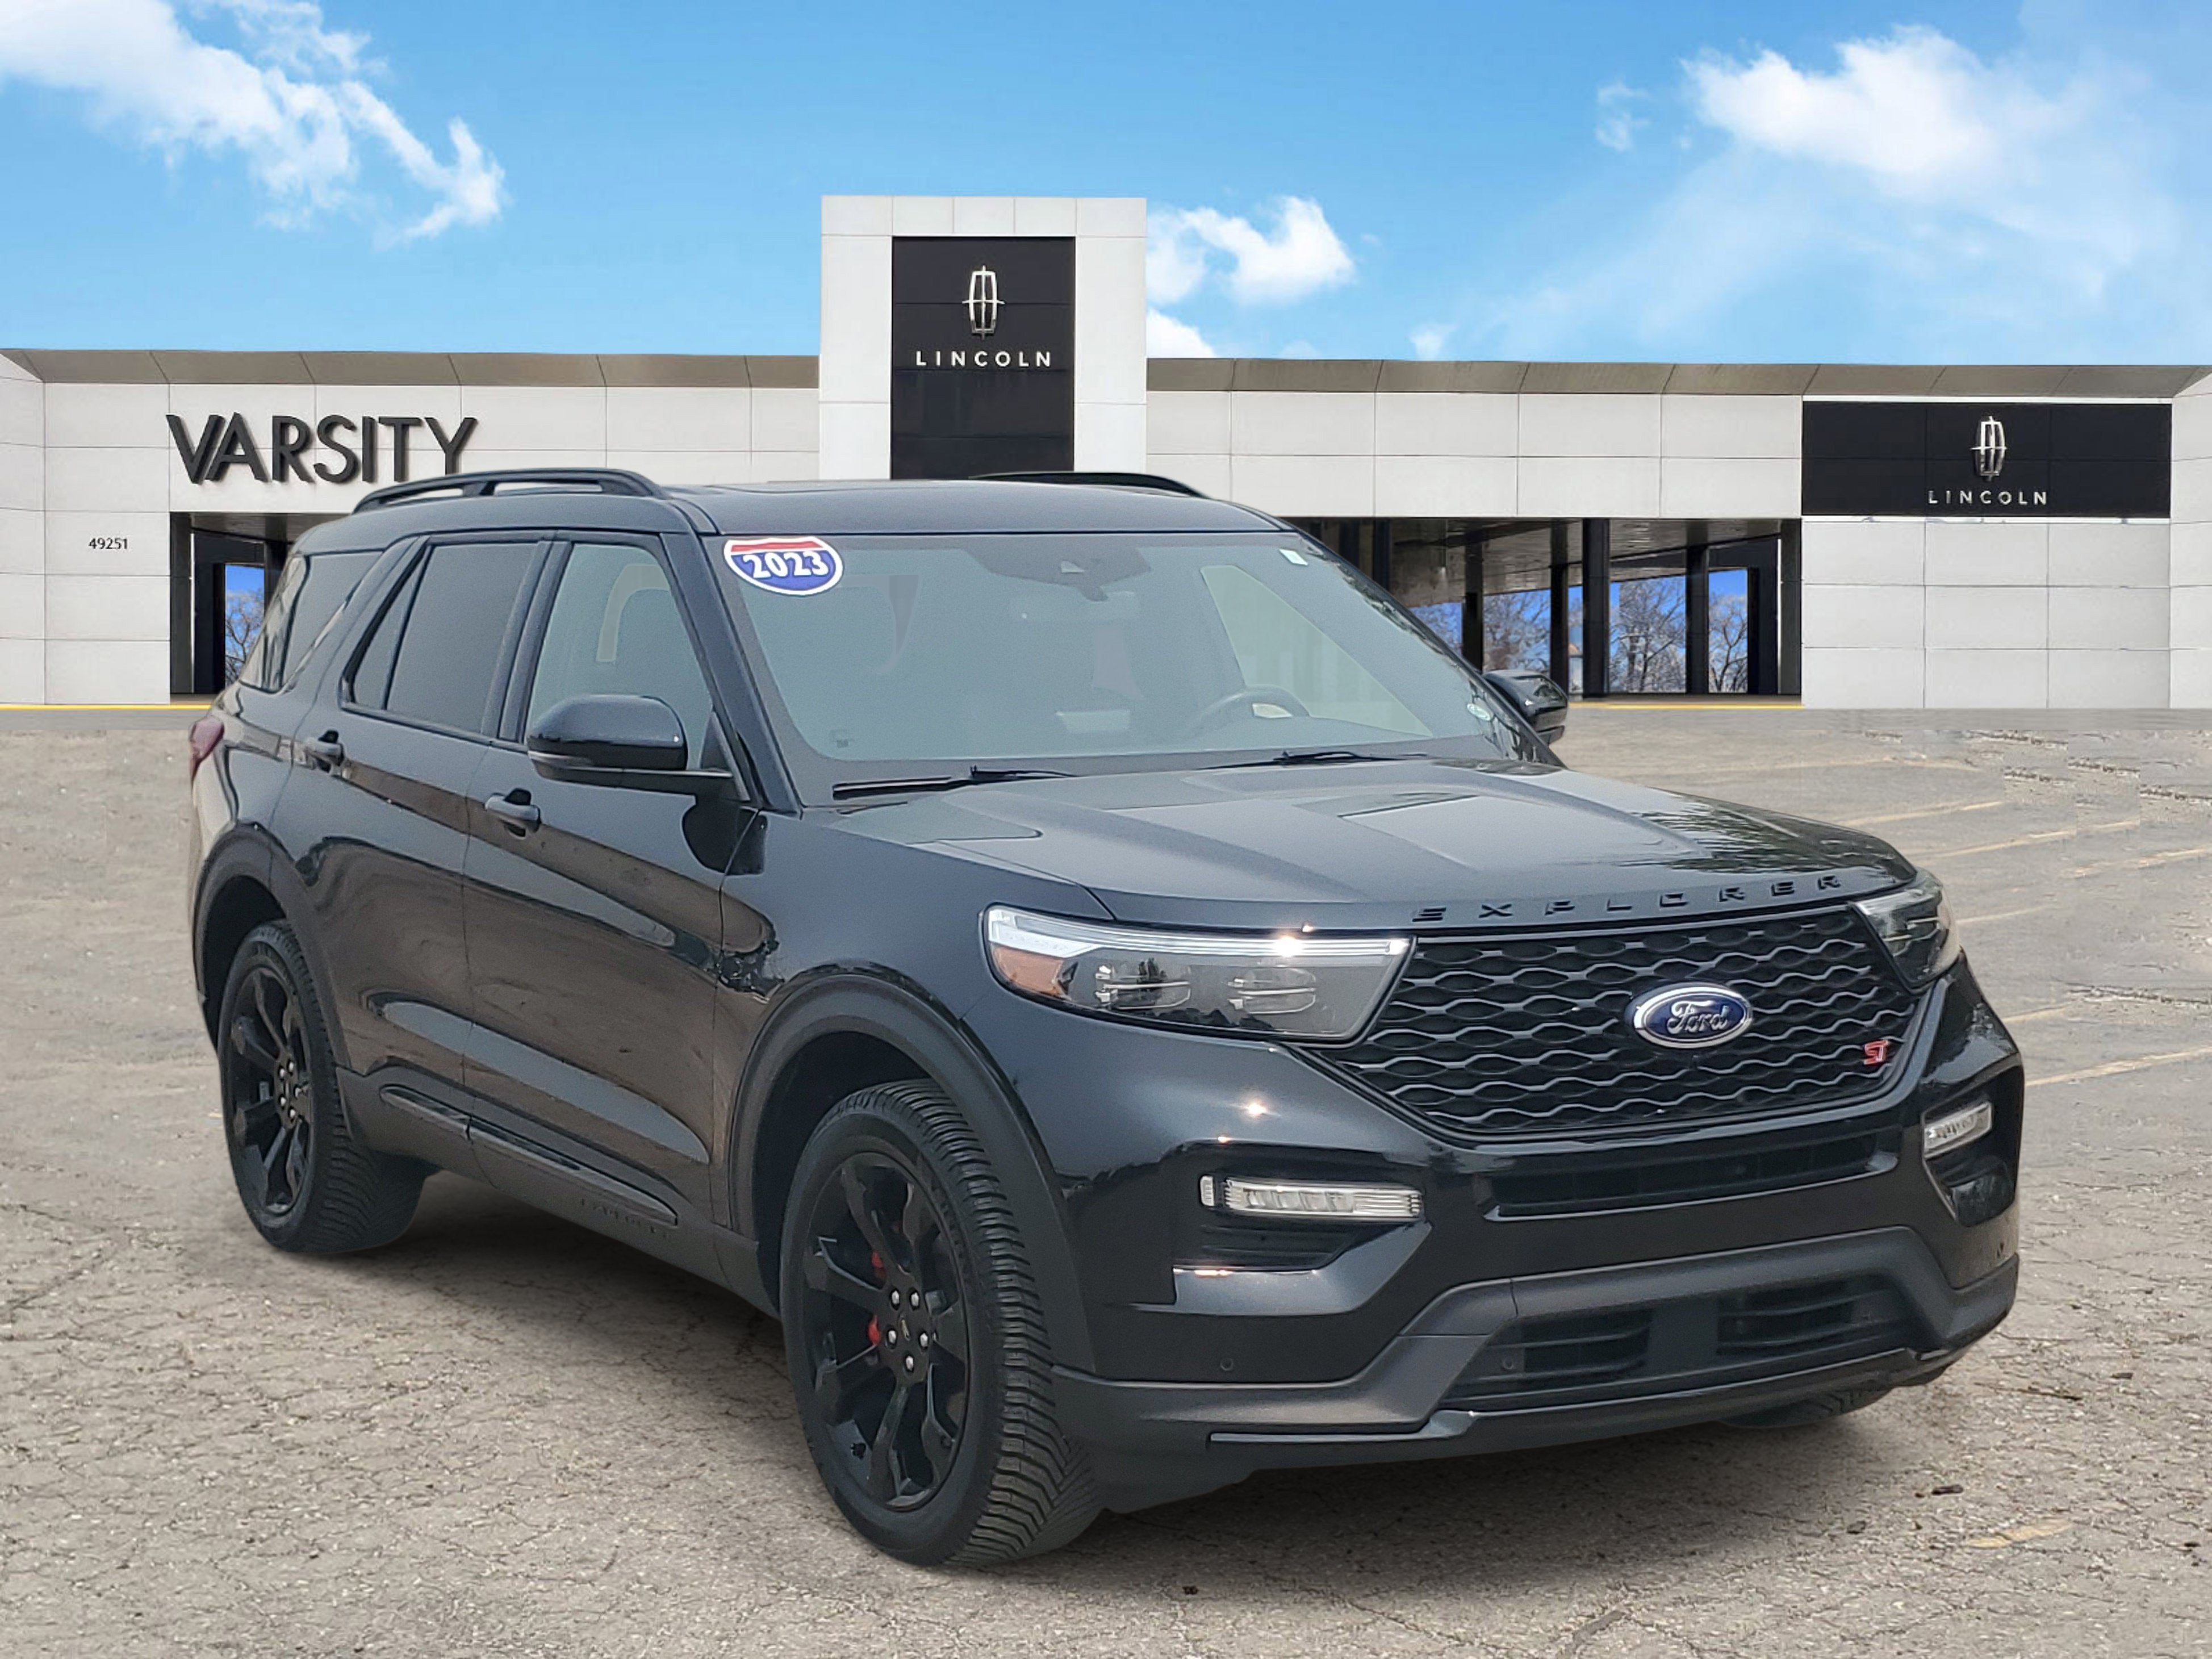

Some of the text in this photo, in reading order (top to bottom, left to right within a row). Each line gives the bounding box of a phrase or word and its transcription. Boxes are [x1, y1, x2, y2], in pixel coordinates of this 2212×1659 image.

[915, 350, 1051, 367] LINCOLN
[166, 412, 478, 484] VARSITY
[1928, 490, 2047, 505] LINCOLN
[88, 537, 127, 549] 49251
[743, 552, 829, 578] 2023
[1412, 875, 1841, 922] EXPLORER
[1666, 1001, 1731, 1034] Ford
[1863, 1040, 1890, 1065] ST
